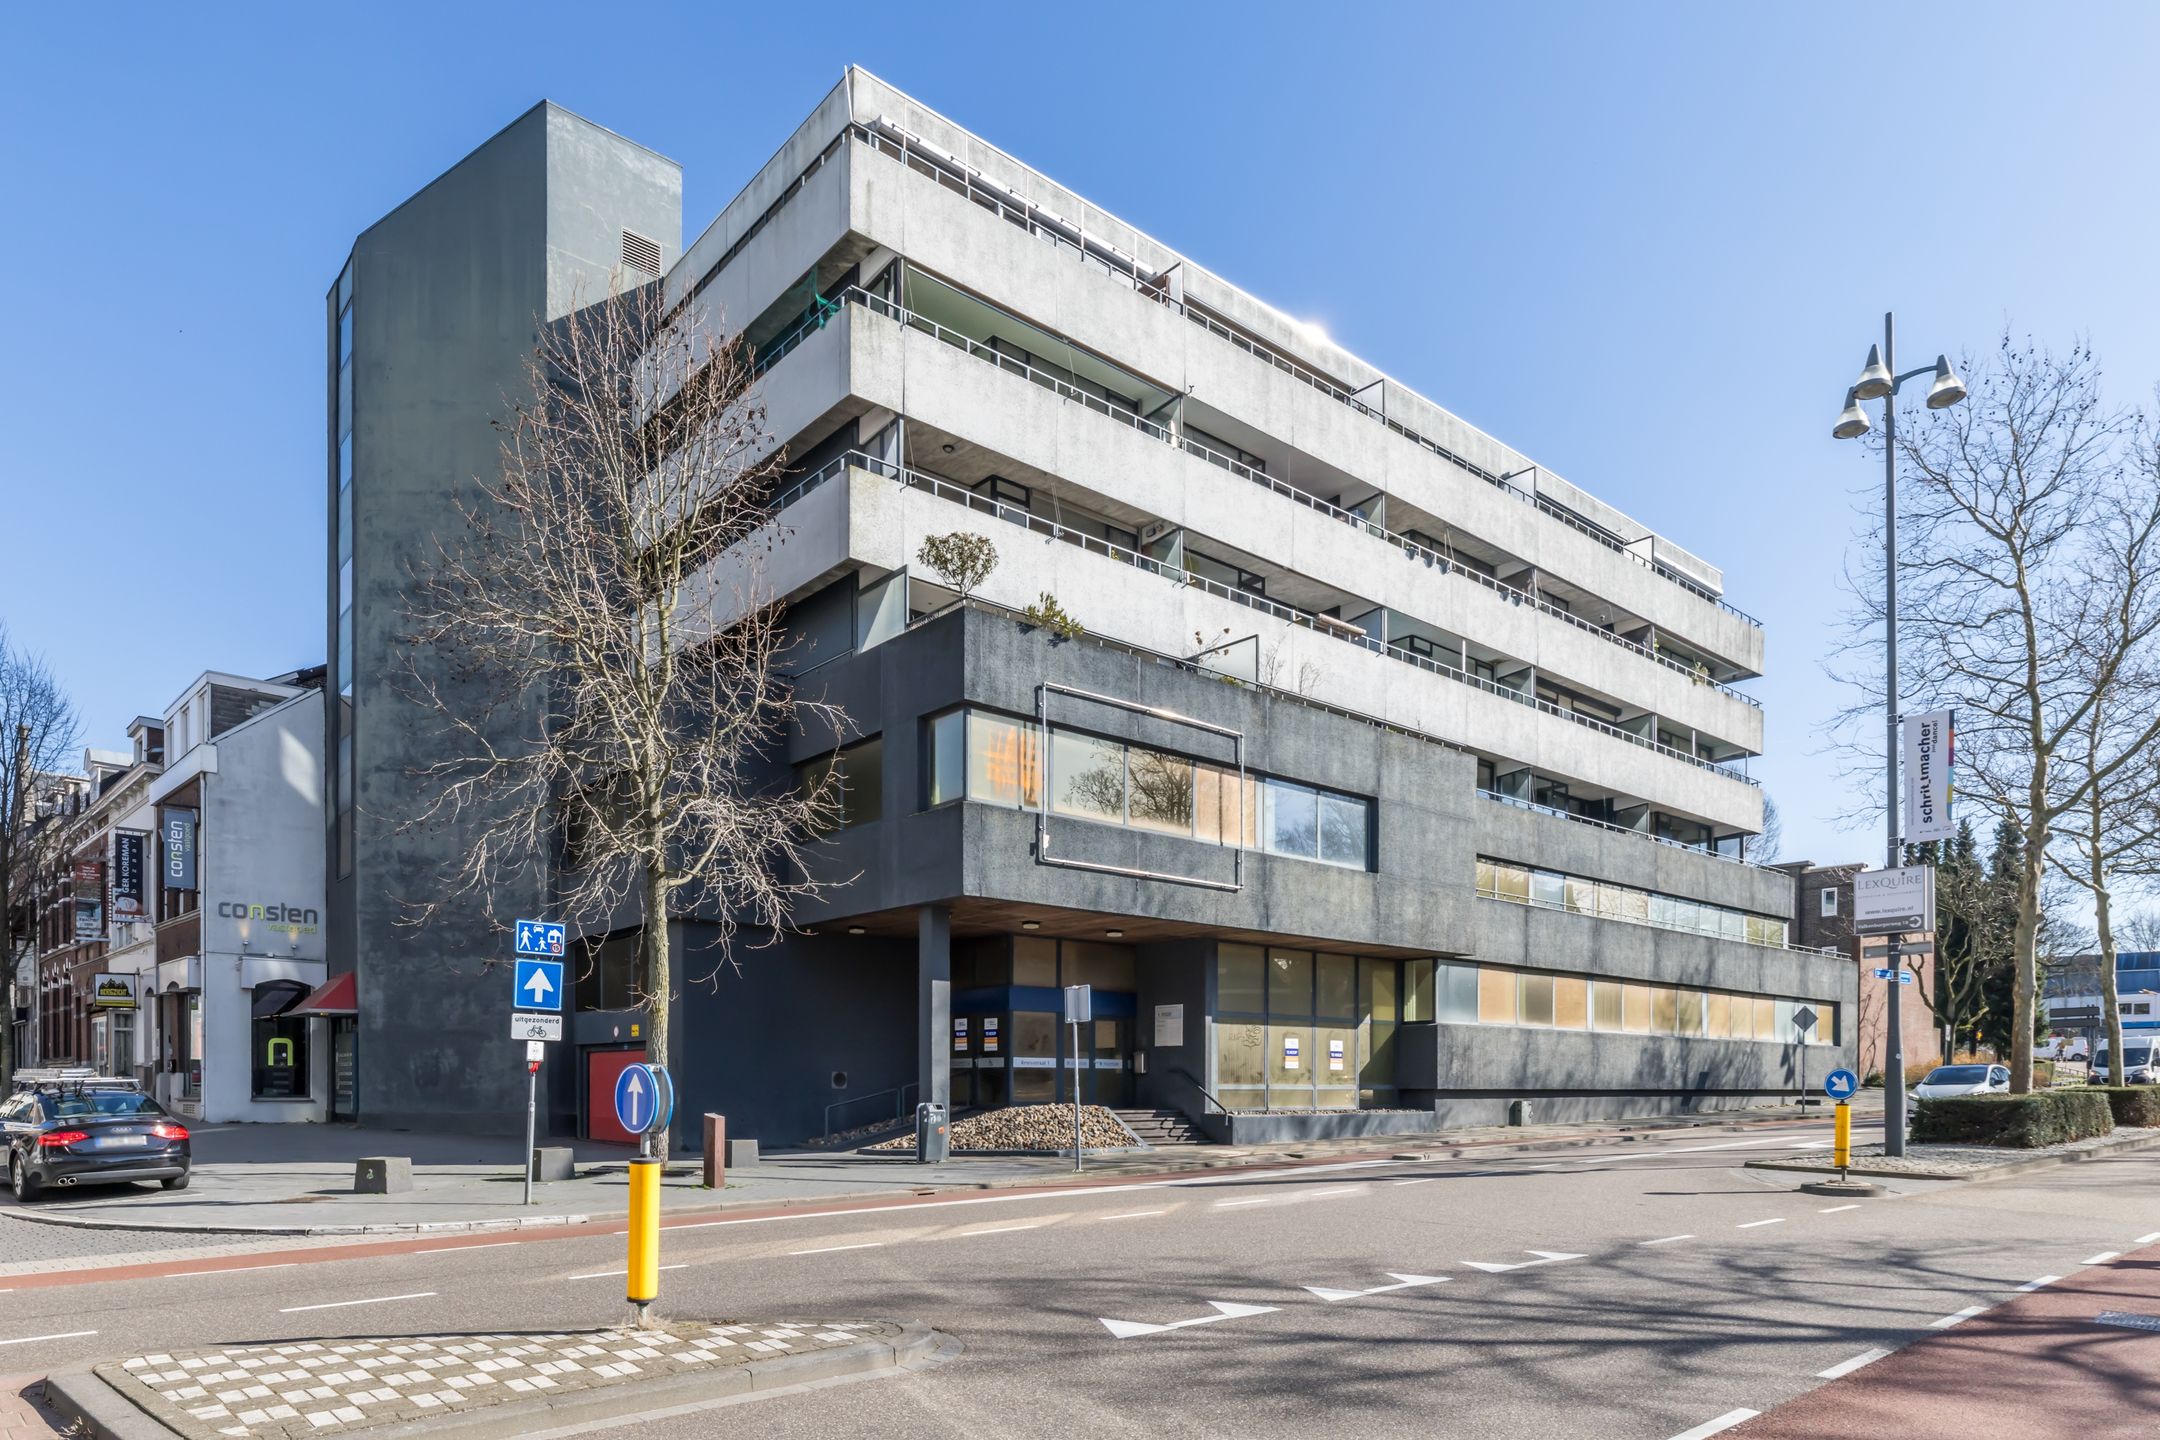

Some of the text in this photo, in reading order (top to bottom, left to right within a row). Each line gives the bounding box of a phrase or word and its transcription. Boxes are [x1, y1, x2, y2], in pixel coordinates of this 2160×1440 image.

[1918, 722, 1932, 823] schrit_tmacher
[122, 837, 130, 894] GER KOREMAN
[168, 821, 183, 877] consten
[218, 902, 318, 924] consten
[515, 1016, 560, 1025] uitgezonderd
